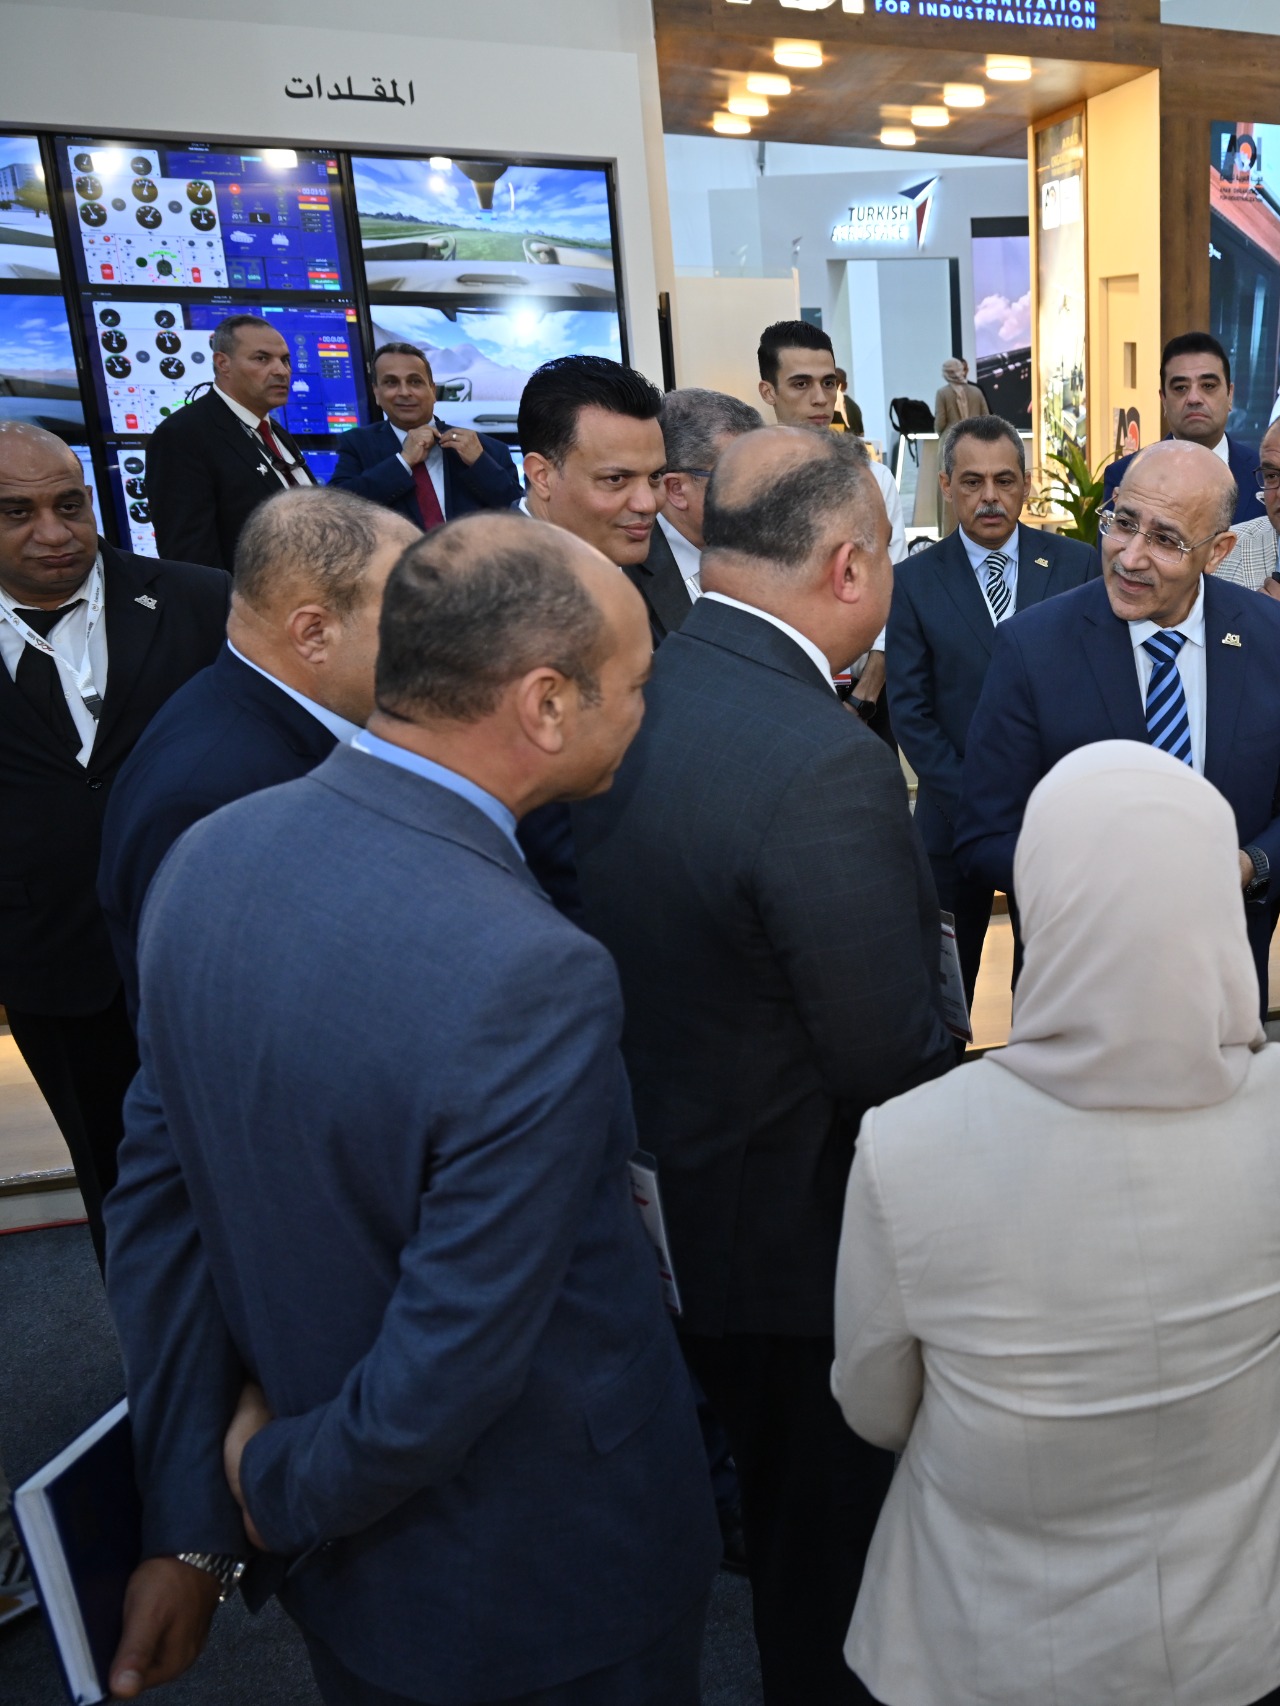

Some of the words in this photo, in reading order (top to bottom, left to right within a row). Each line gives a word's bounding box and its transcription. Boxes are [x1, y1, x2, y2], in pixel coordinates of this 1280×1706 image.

[875, 0, 910, 14] FOR
[918, 2, 1097, 30] INDUSTRIALIZATION
[284, 73, 415, 106] المقلدات
[848, 205, 909, 222] TURKISH
